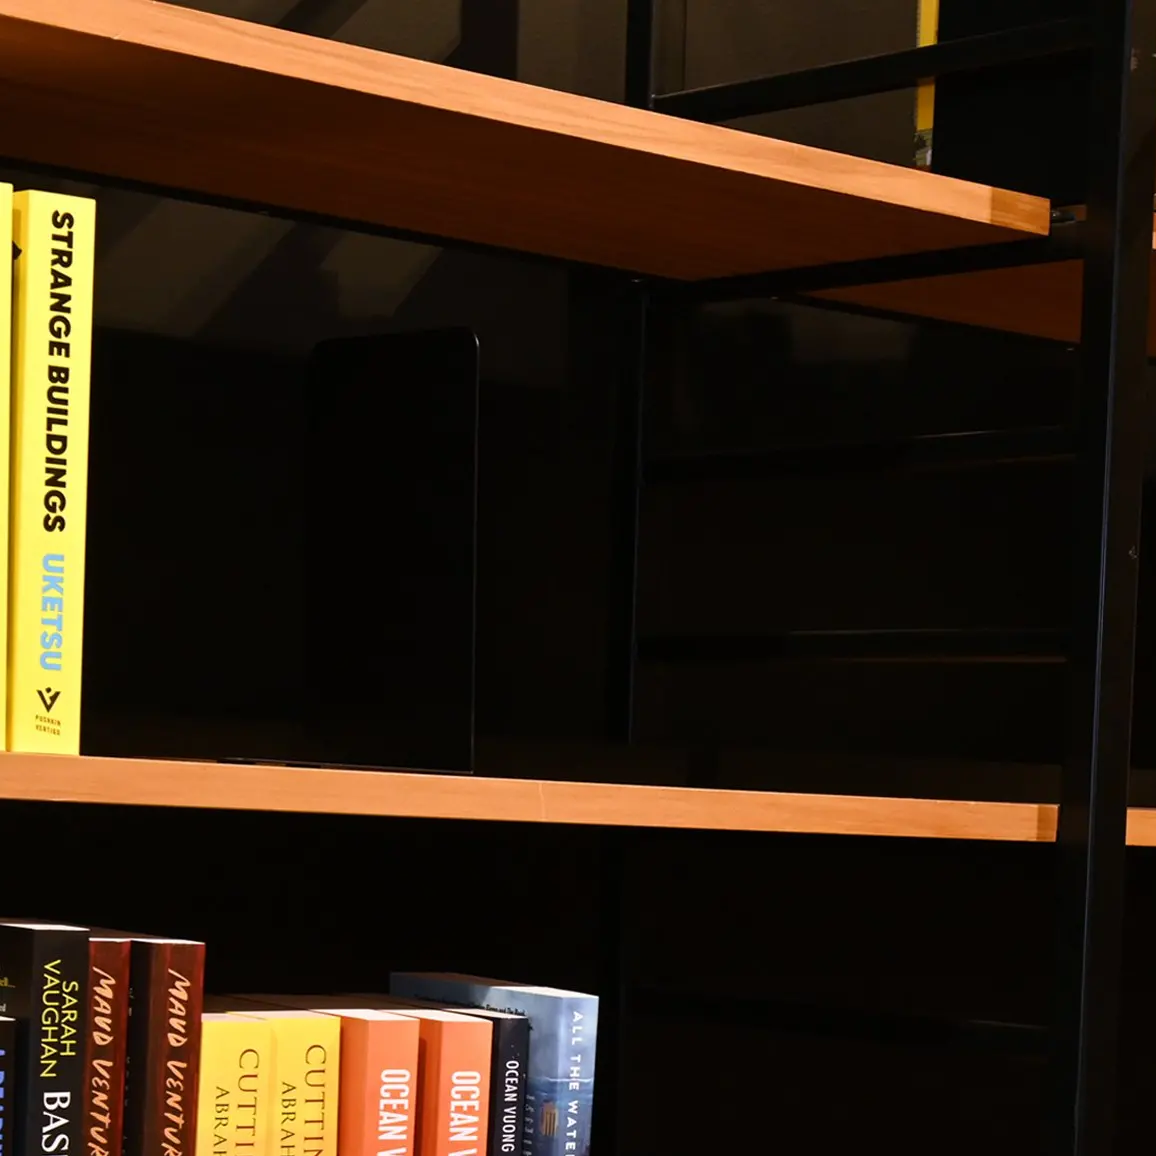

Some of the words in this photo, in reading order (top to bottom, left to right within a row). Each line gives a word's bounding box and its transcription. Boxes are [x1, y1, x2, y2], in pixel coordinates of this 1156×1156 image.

[48, 210, 75, 358] STRANGE
[43, 364, 72, 534] BUILDINGS
[39, 553, 65, 672] UKETSU
[40, 959, 62, 1078] VAUGHAN
[60, 980, 79, 1056] SARAH
[92, 966, 116, 1046] MAUD
[167, 968, 191, 1047] MAUD
[572, 1011, 584, 1046] ALL
[377, 1068, 411, 1141] OCEAN
[448, 1071, 481, 1141] OCEAN
[504, 1060, 519, 1102] OCEAN
[569, 1054, 582, 1091] THE
[501, 1105, 517, 1152] VUONG
